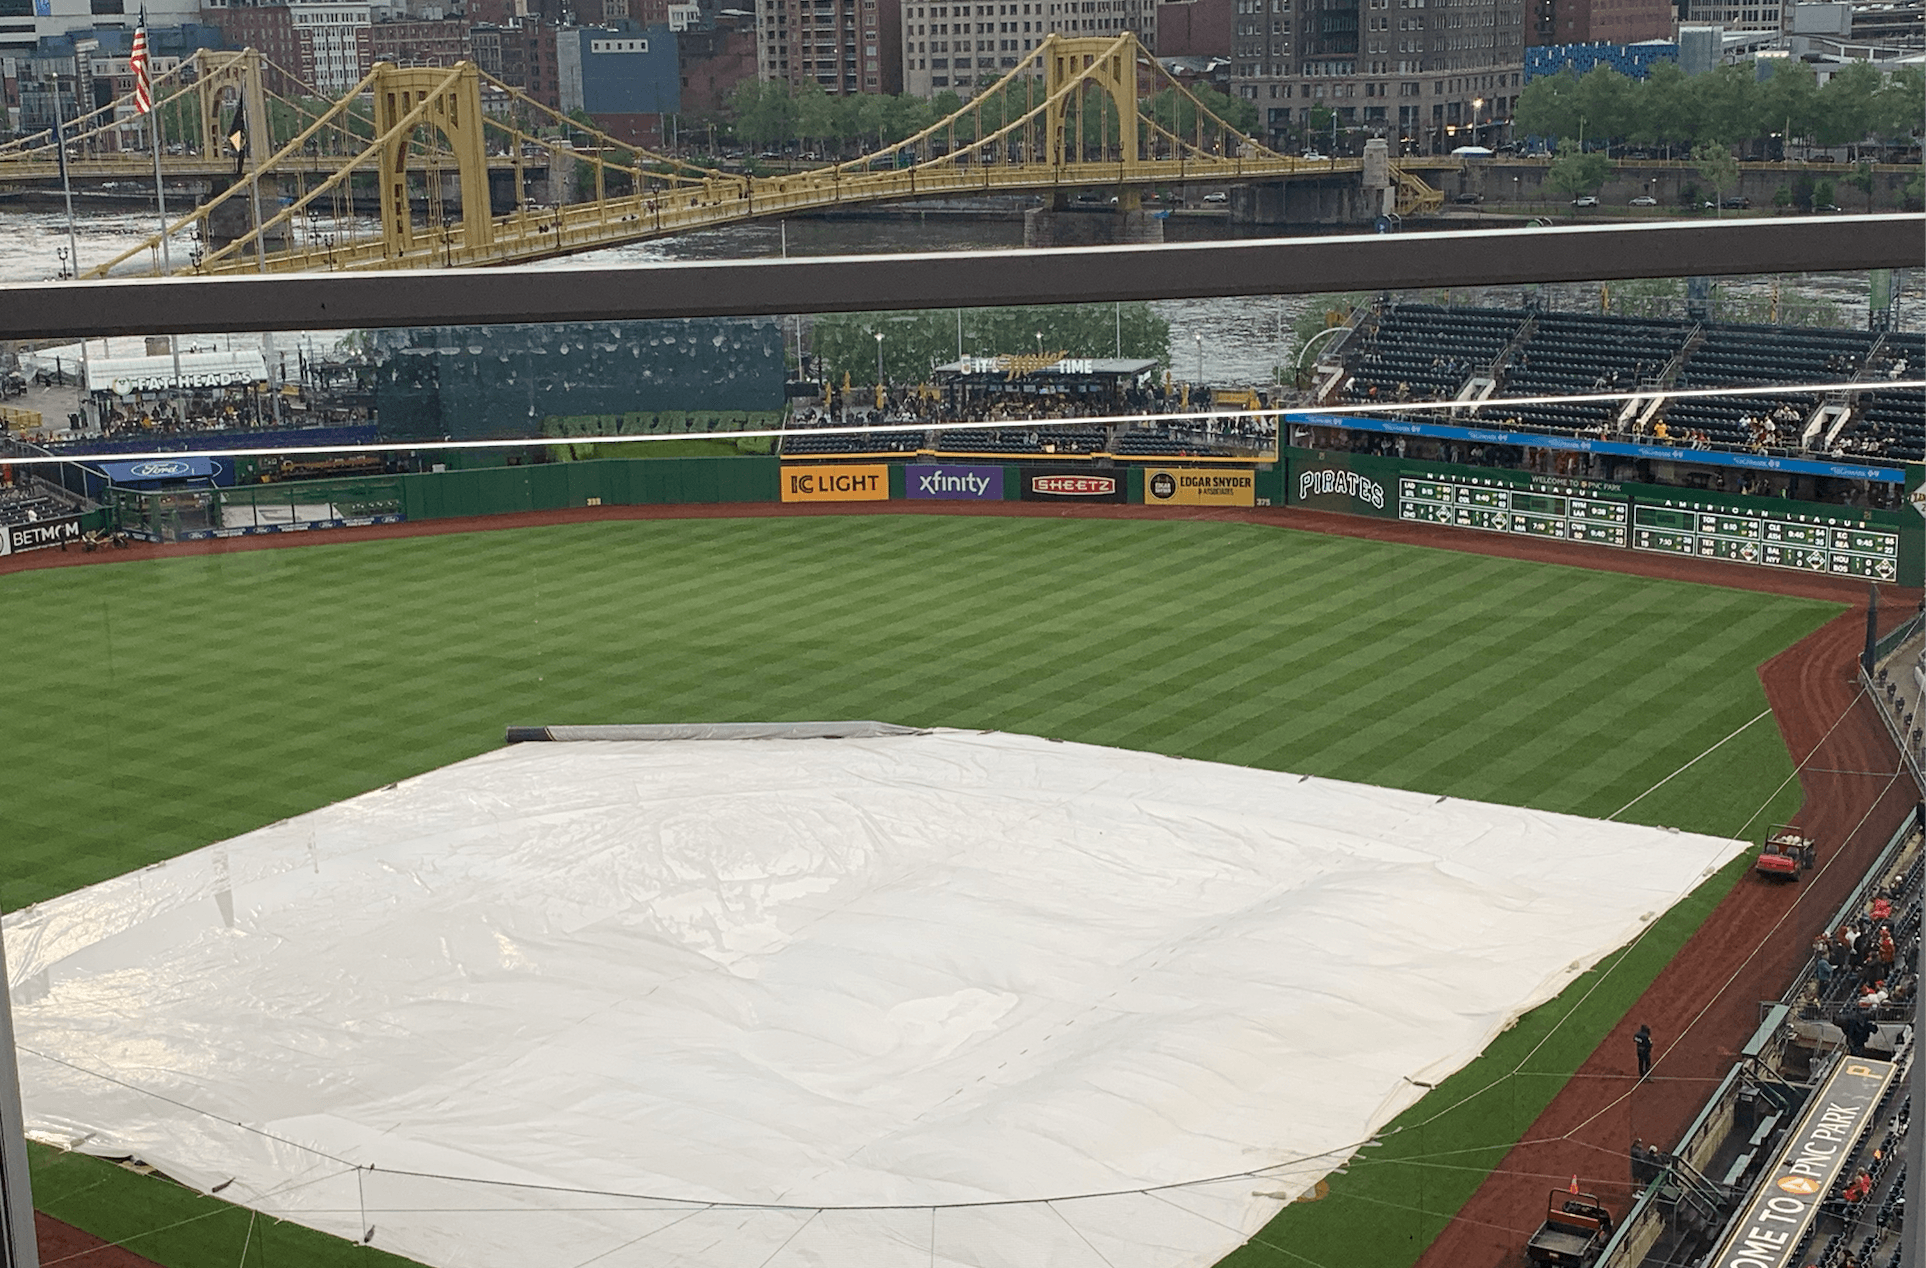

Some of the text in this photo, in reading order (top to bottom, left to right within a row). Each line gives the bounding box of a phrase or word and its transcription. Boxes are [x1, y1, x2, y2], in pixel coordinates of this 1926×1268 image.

[1059, 359, 1093, 374] TIME
[138, 376, 171, 391] FAT
[141, 464, 179, 476] Ford
[791, 475, 879, 494] IC LIGHT
[919, 470, 991, 496] xfinity
[1037, 479, 1110, 491] SHEETZ
[1180, 476, 1252, 488] EDGAR SNYDER
[1300, 470, 1384, 510] PIRATES
[1427, 473, 1598, 498] NATIONAL LEAGUE
[1530, 476, 1622, 492] WELCOME TO PNC PARK
[1256, 498, 1270, 506] 375
[1665, 500, 1768, 517] AMERICAN
[1786, 513, 1866, 528] LEAGUE
[1833, 555, 1850, 564] HOU
[1846, 1064, 1883, 1080] P
[1810, 1102, 1860, 1142] PARK
[1789, 1142, 1838, 1178] PNC
[1758, 1197, 1804, 1224] TO
